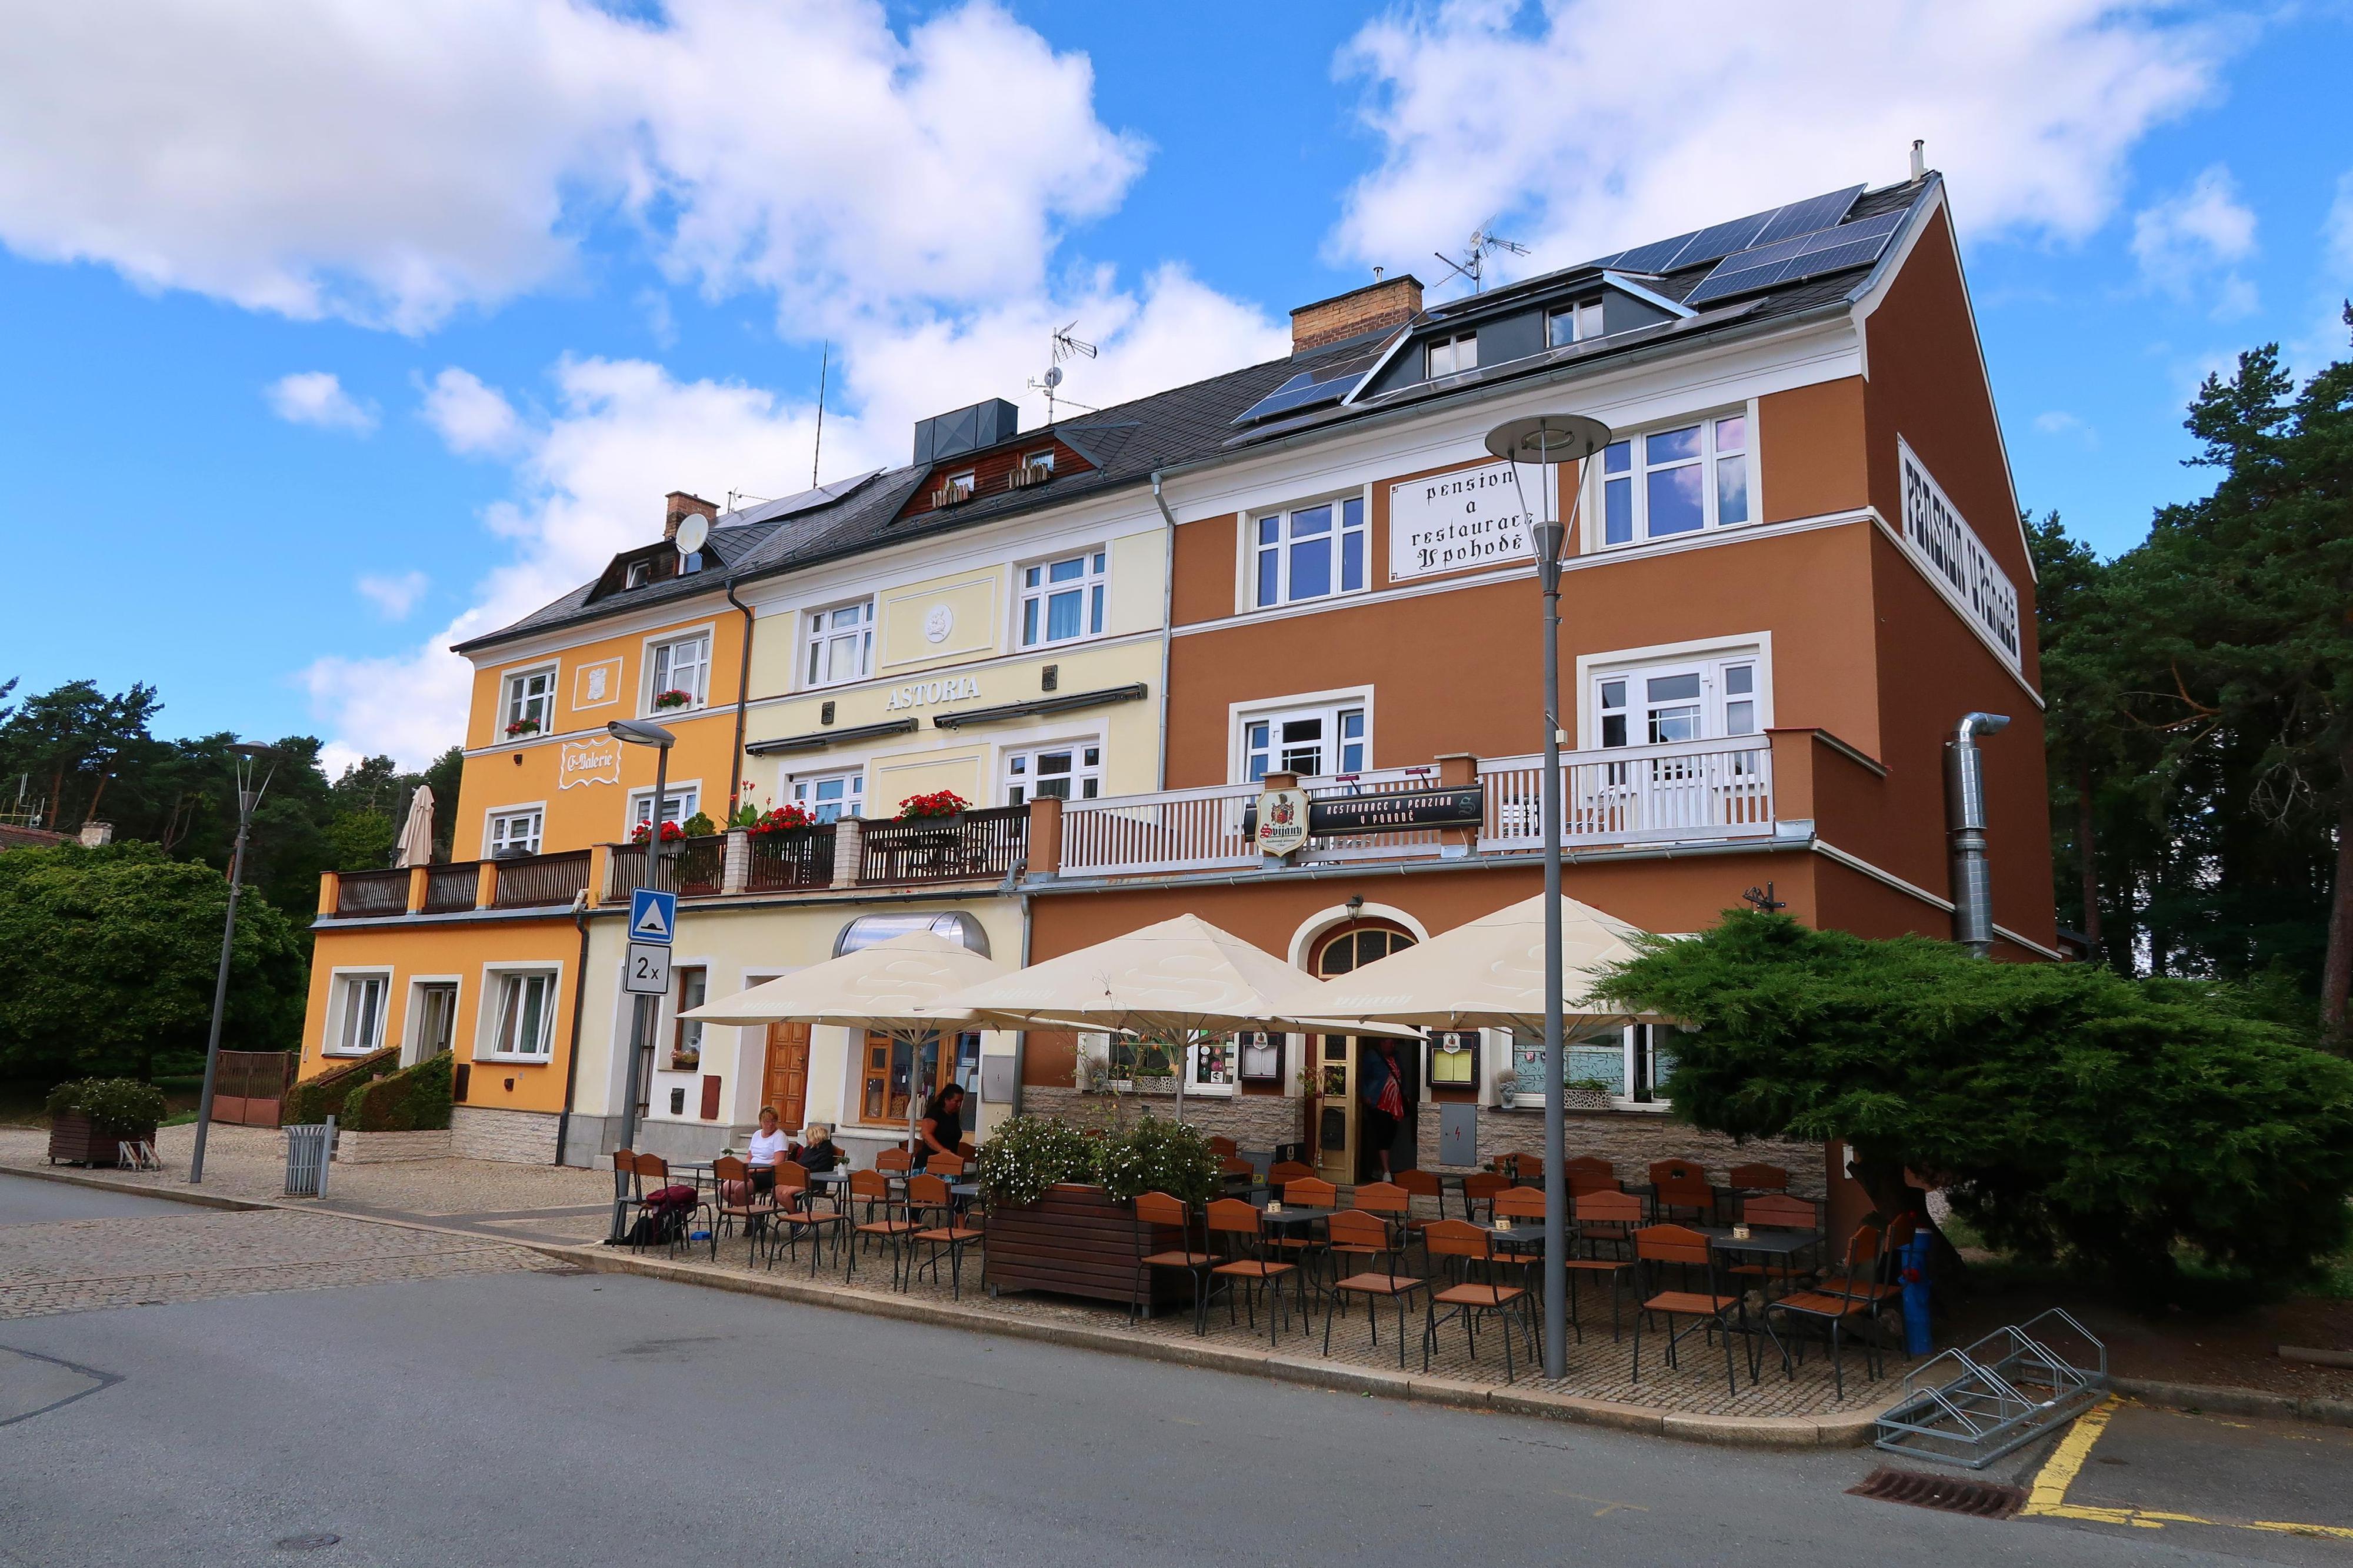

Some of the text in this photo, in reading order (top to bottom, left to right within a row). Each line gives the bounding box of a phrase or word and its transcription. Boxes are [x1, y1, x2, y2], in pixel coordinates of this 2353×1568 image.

[1426, 471, 1514, 507] pension
[1466, 501, 1477, 513] a
[1412, 512, 1534, 546] restaurace
[885, 676, 981, 711] ASTORIA
[1327, 796, 1452, 815] RESTAURACE A PENZION
[1360, 810, 1414, 825] V POHODĚ
[1260, 823, 1302, 838] Svijany
